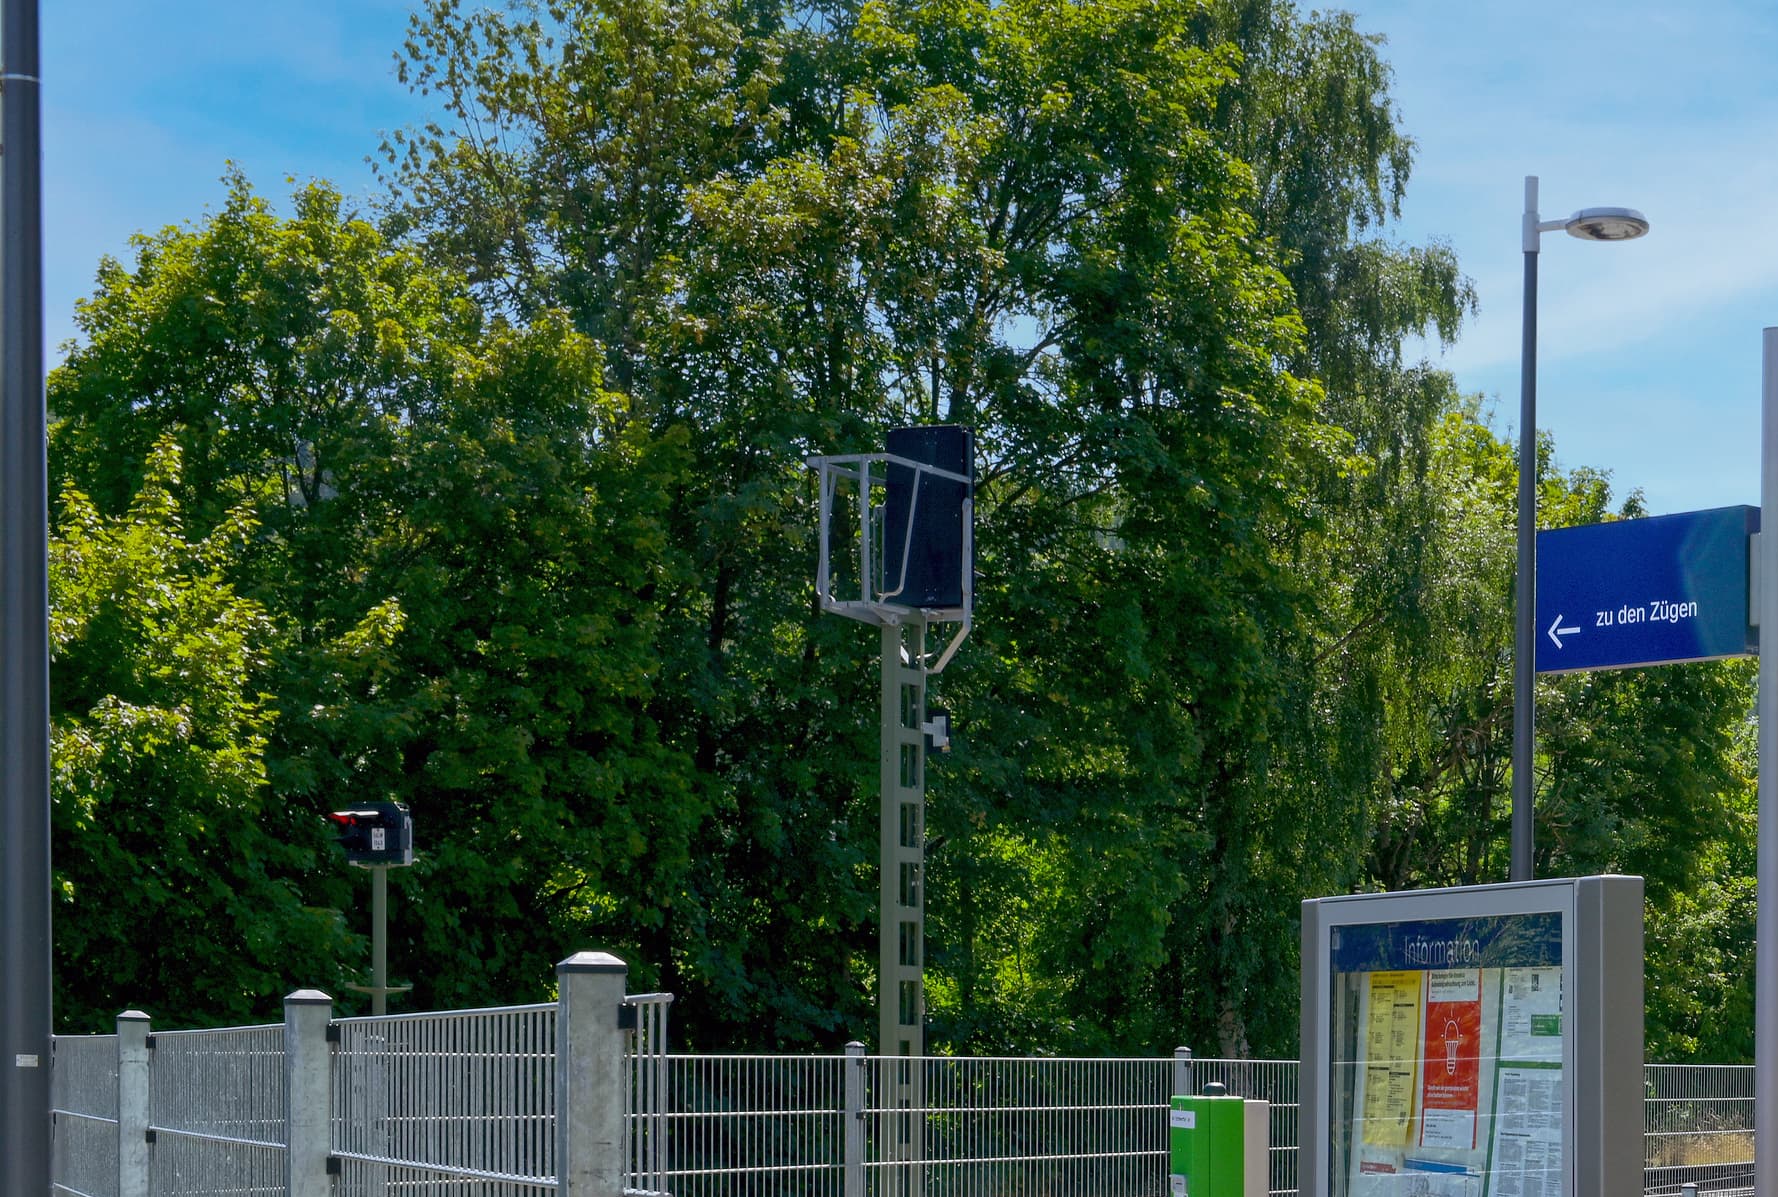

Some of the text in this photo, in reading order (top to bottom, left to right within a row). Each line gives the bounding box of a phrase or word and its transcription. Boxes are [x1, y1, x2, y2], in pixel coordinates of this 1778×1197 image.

[1596, 600, 1697, 627] zu den Zügen
[1404, 935, 1480, 966] Information
